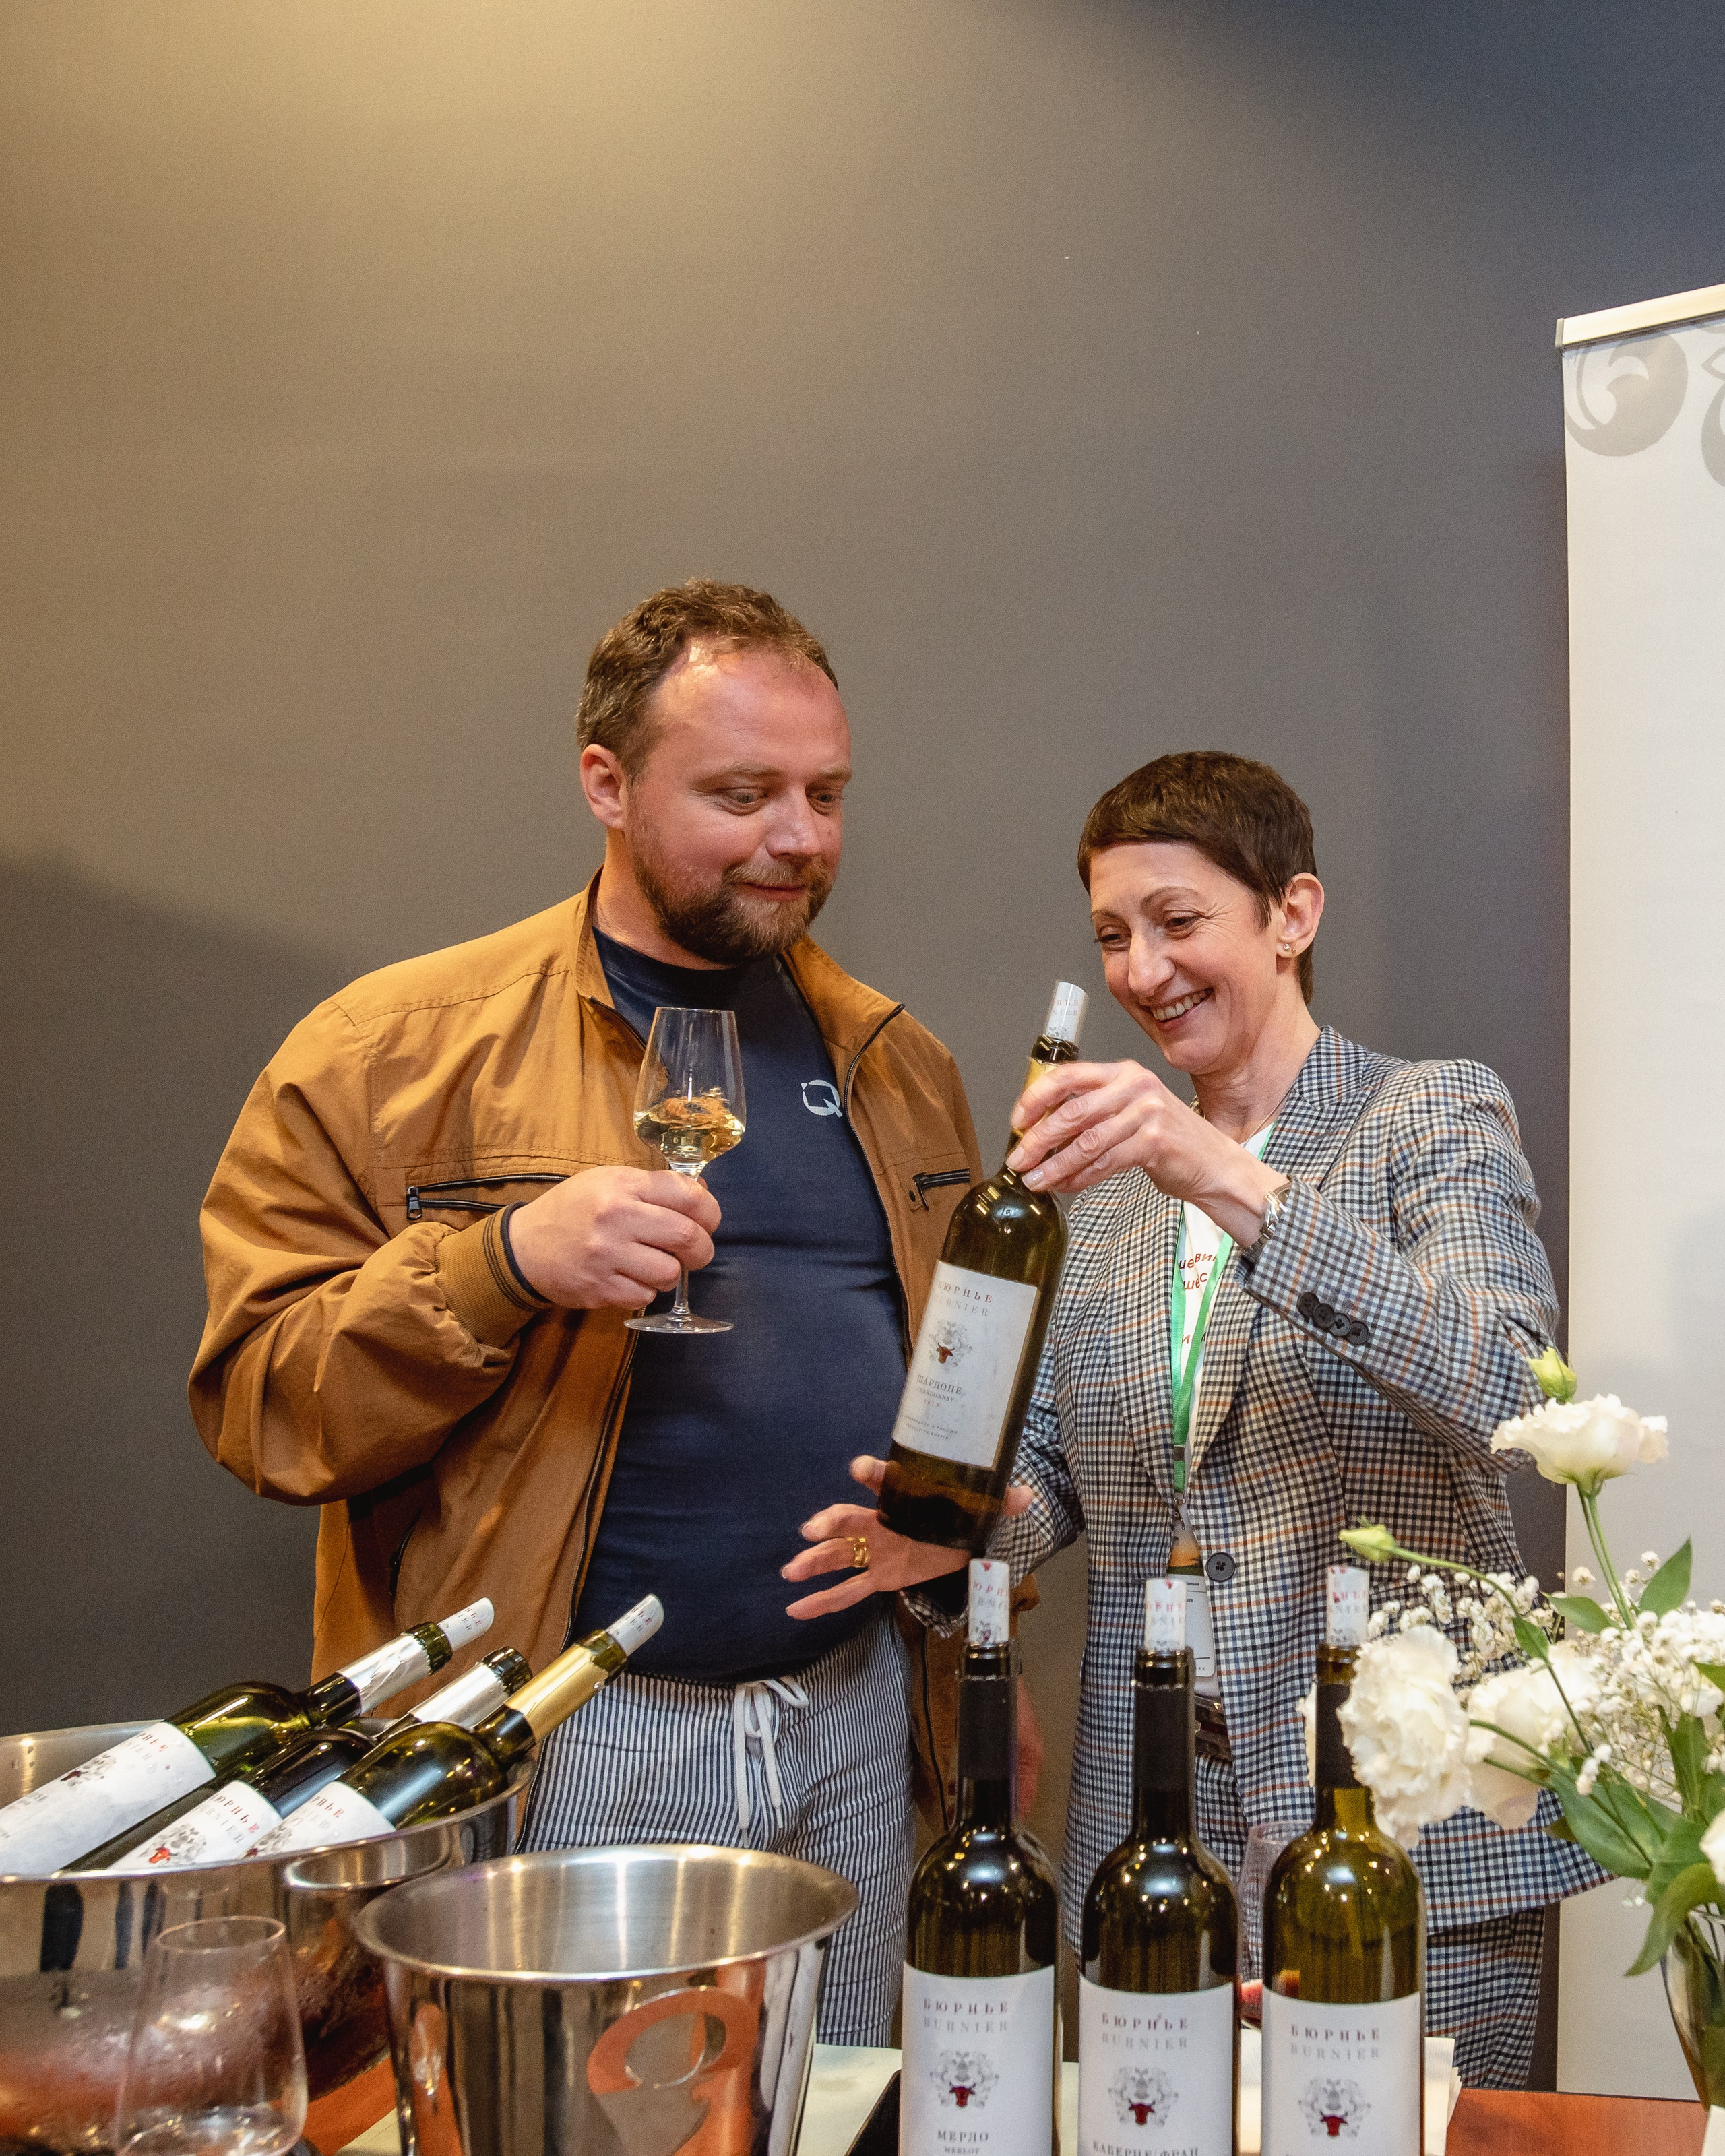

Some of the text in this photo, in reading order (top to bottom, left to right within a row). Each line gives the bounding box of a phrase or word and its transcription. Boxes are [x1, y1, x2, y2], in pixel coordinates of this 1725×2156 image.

[937, 1281, 993, 1303] БЮРНЬЕ
[917, 1374, 962, 1395] ШАРДОНЕ
[924, 1998, 1008, 2015] БЮРНЬЕ
[924, 2017, 1007, 2033] BURNIER
[1102, 2013, 1187, 2030] БЮРНЬЕ
[1102, 2032, 1187, 2050] BURNIER
[1291, 2024, 1379, 2041] БЮРНЬЕ
[1291, 2043, 1379, 2060] BURNIER
[937, 2129, 989, 2143] МЕРЛО
